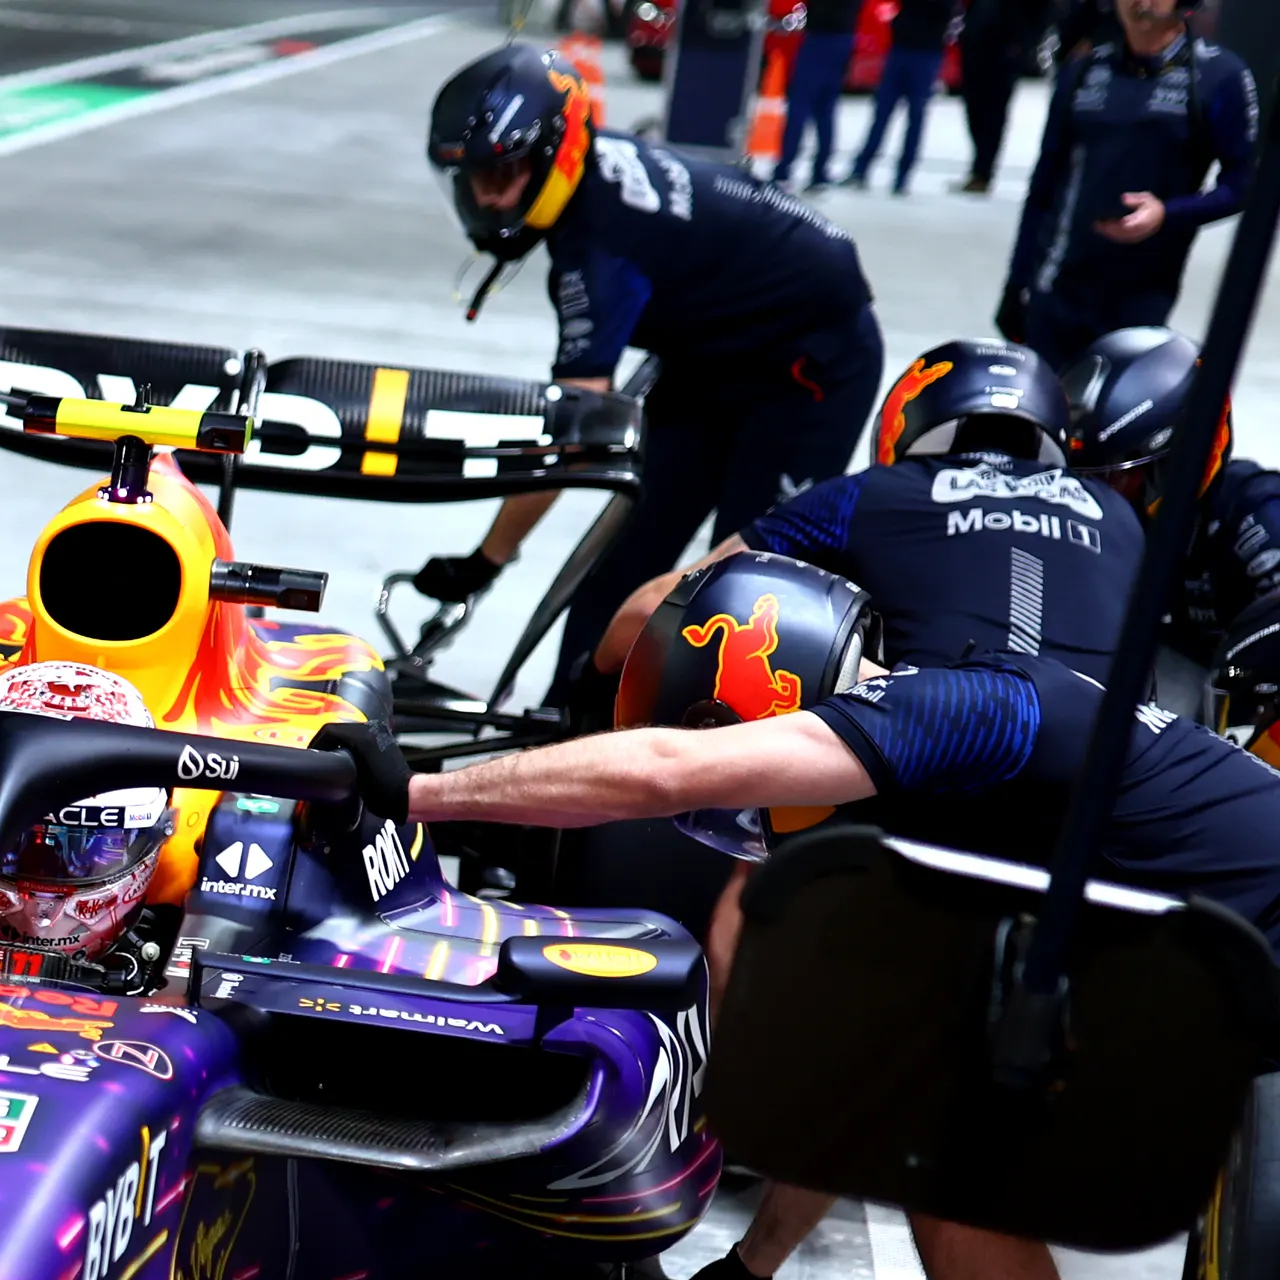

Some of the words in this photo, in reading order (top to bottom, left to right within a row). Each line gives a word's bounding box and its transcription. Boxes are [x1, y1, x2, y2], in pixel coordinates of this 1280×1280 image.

[946, 508, 1062, 540] Mobil
[205, 752, 239, 780] Sui
[200, 877, 277, 901] inter.mx
[22, 934, 80, 947] inter.mx
[12, 952, 43, 977] 11
[349, 1003, 505, 1035] Walmart
